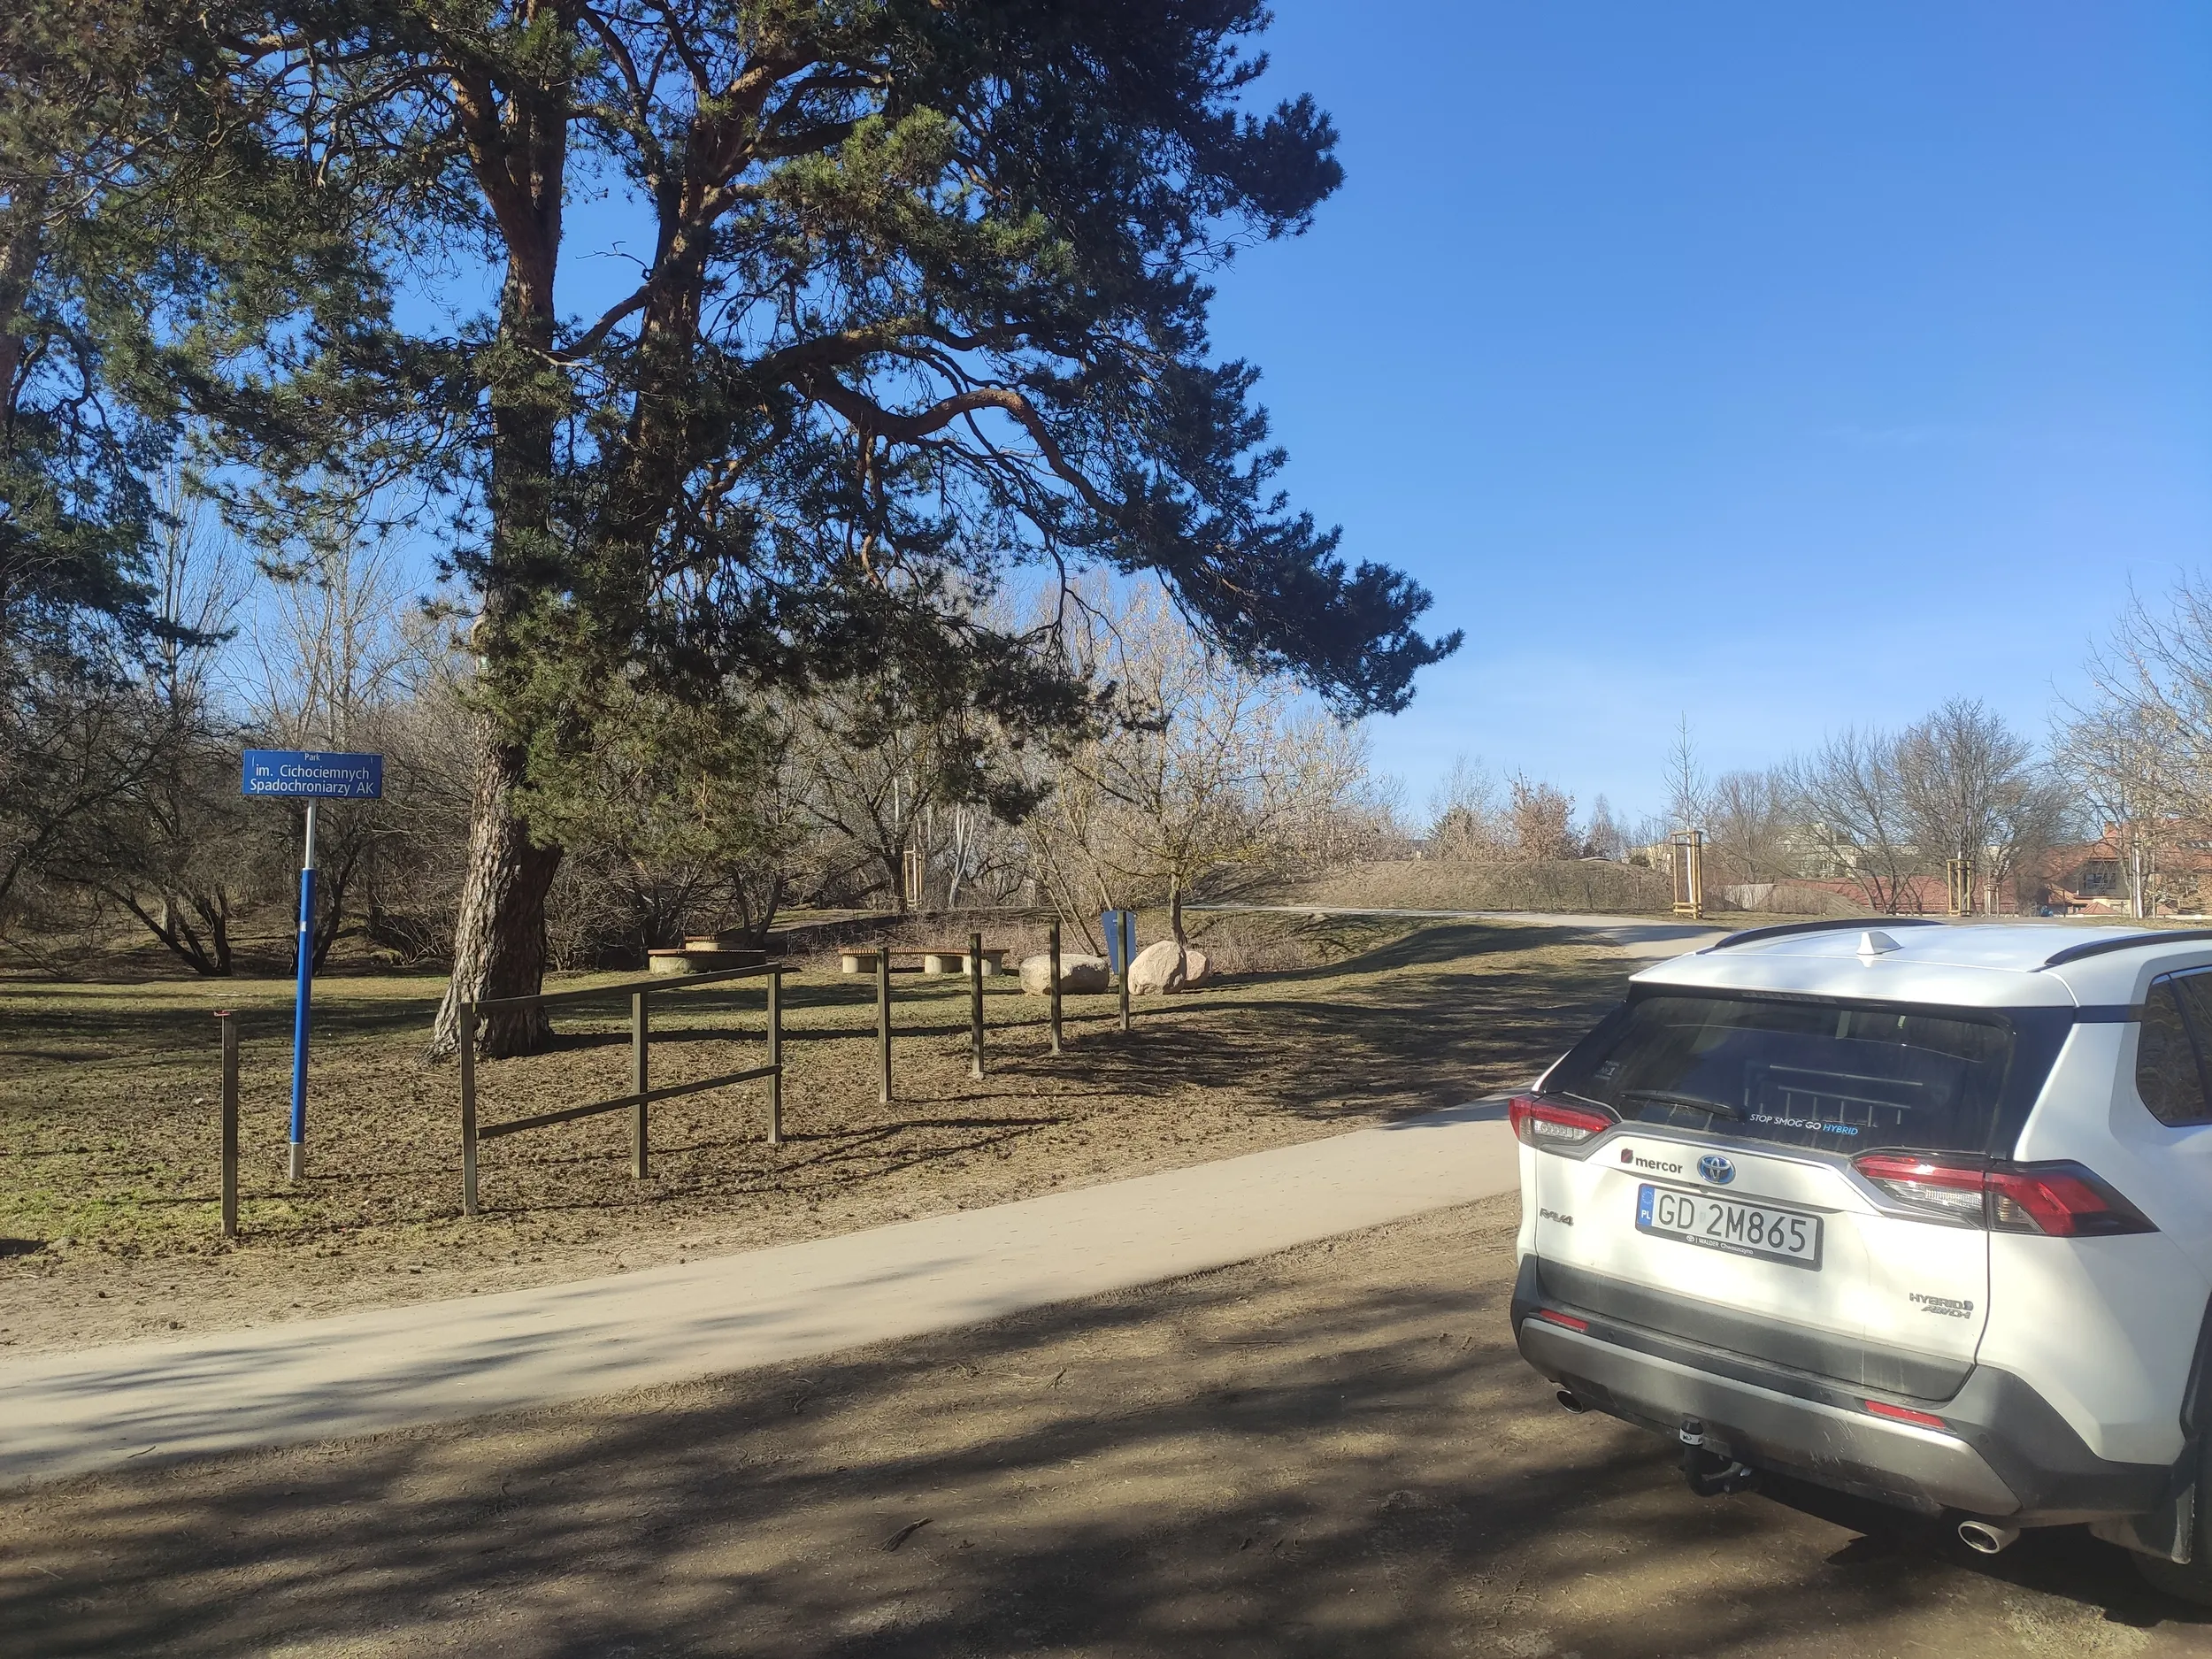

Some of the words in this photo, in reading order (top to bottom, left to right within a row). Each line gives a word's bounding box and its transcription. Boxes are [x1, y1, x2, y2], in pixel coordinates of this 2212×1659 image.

[256, 764, 273, 777] im.
[280, 764, 370, 782] Cichociemnych
[250, 779, 350, 796] Spadochroniarzy
[356, 782, 374, 794] AK
[1750, 1114, 1772, 1123] STOP
[1774, 1117, 1803, 1127] SMOG
[1805, 1121, 1822, 1130] GO
[1823, 1124, 1858, 1135] HYBRID
[1635, 1157, 1683, 1174] mercor
[1540, 1207, 1574, 1227] RAV4
[1640, 1210, 1651, 1219] PL
[1658, 1194, 1694, 1230] GD
[1706, 1203, 1807, 1253] 2M865
[1699, 1238, 1719, 1248] WALDER
[1909, 1293, 1963, 1310] HYBRID
